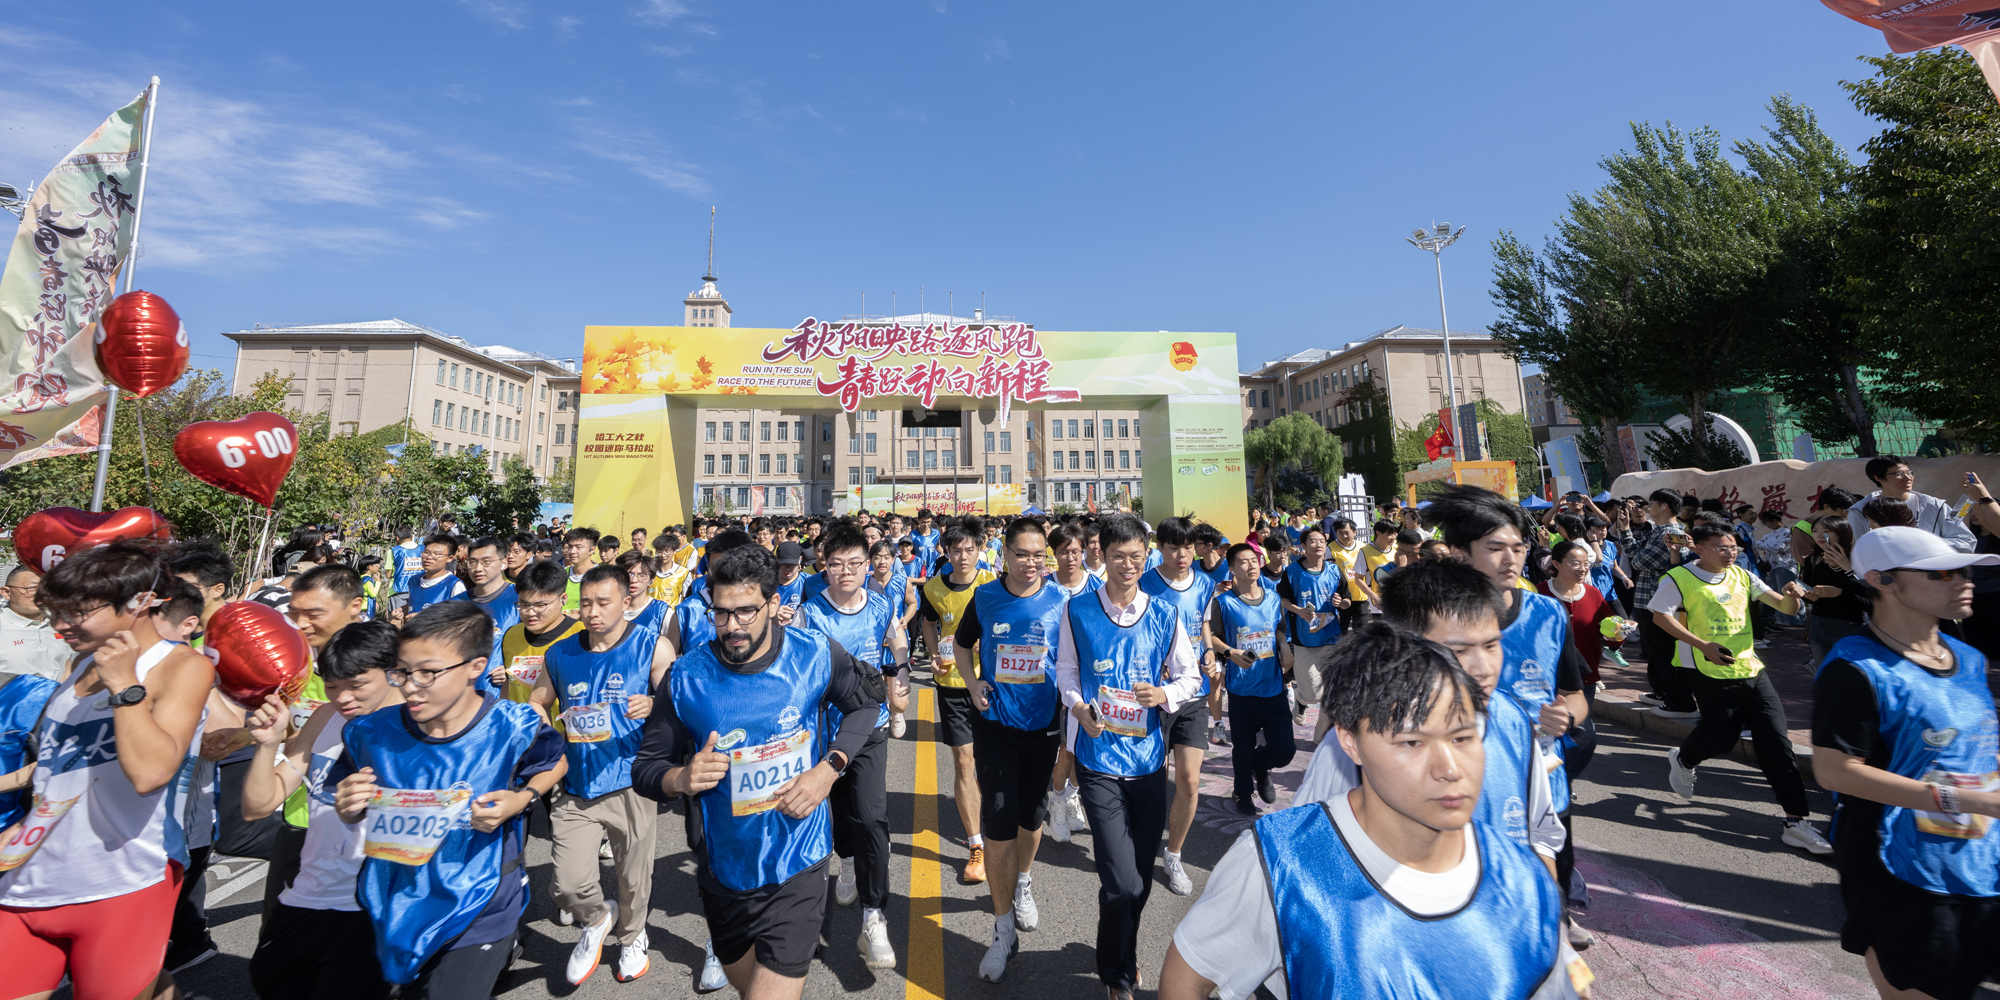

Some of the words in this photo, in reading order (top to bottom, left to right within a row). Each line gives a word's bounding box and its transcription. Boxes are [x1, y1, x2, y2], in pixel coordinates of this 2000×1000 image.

[742, 365, 761, 374] RUN
[763, 366, 773, 374] IN
[775, 366, 792, 374] THE
[793, 366, 813, 375] SUN
[717, 377, 743, 385] RACE
[744, 378, 756, 386] TO
[758, 378, 776, 386] THE
[776, 378, 812, 387] FUTURE
[594, 432, 645, 442] 哈工大之秋
[216, 427, 293, 469] 6:00
[584, 443, 654, 453] 校园迷你马拉松
[1001, 657, 1041, 672] B1277
[1101, 701, 1143, 723] B1097
[738, 756, 805, 793] A0214
[371, 813, 450, 839] A0203
